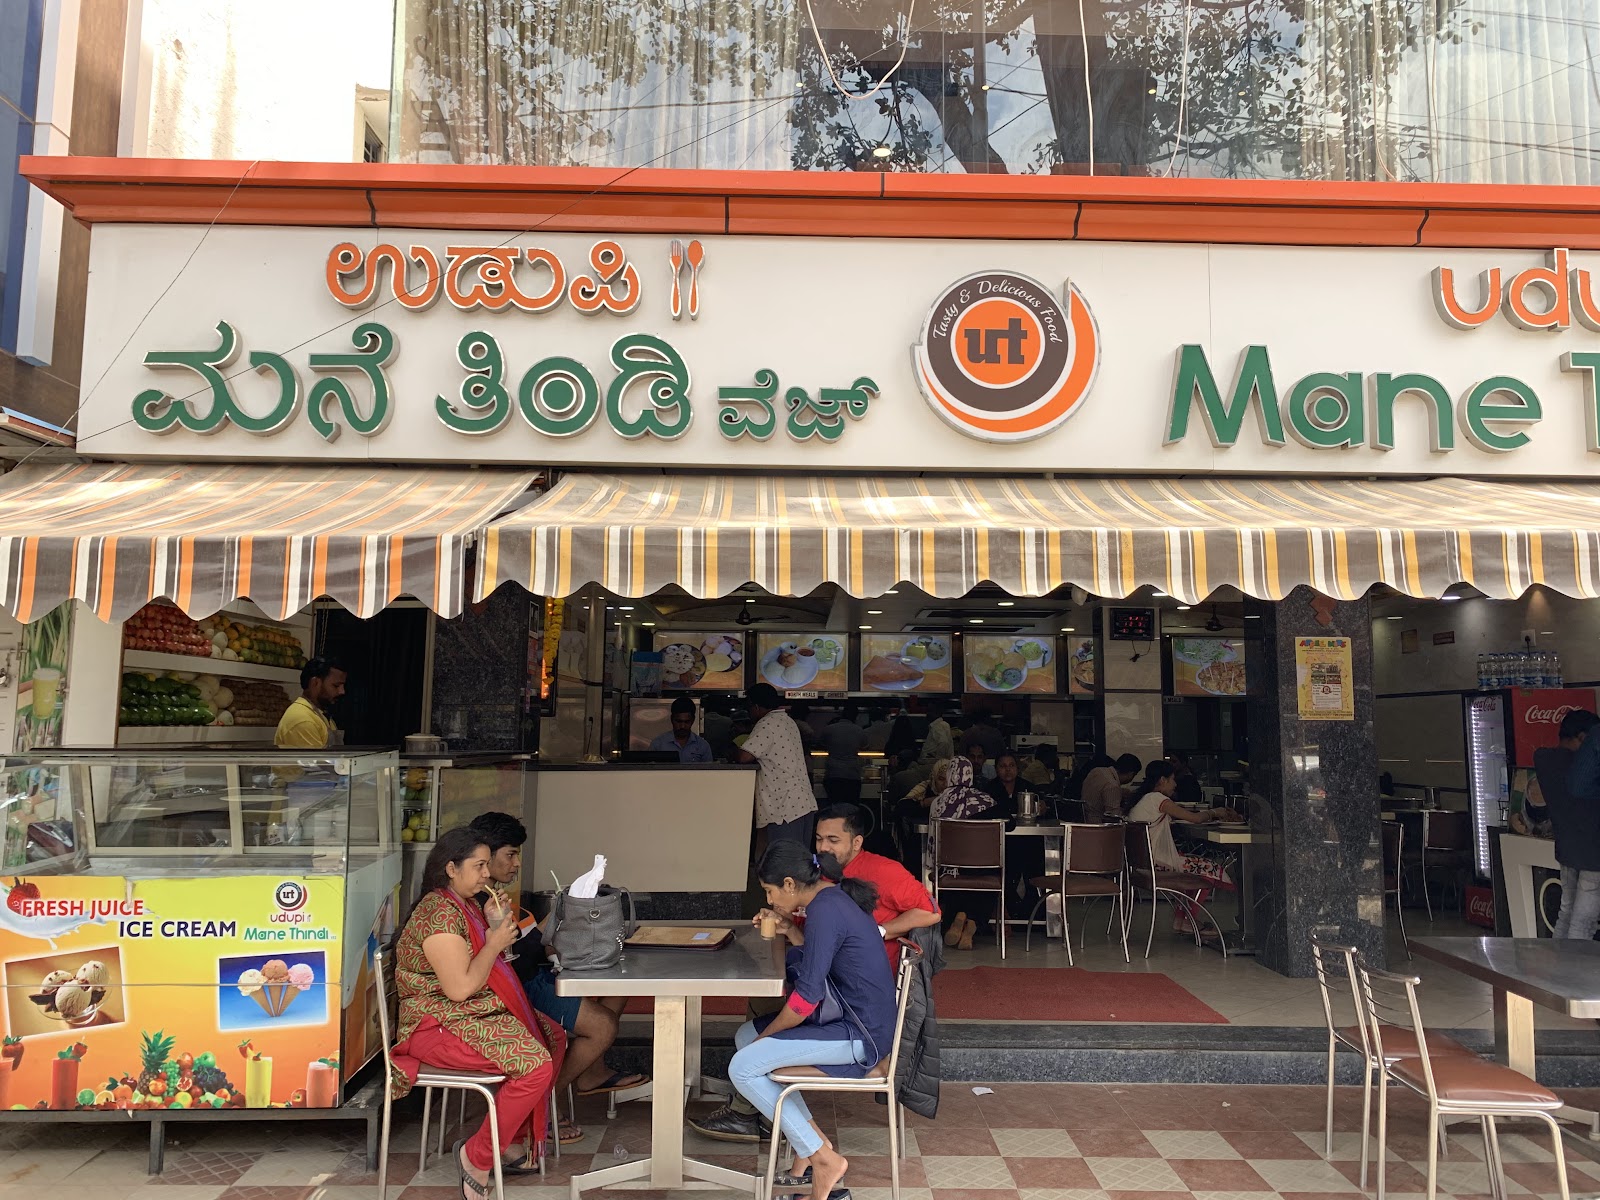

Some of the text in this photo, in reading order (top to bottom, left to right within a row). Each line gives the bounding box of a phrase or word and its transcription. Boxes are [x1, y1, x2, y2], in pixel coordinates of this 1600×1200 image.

[326, 239, 641, 315] ಉಡುಪಿ
[933, 279, 1063, 343] Tasty & Delicious Food
[131, 320, 881, 444] ಮನೆ ತಿಂಡಿ ವೆಜ್
[1162, 344, 1543, 454] Mane
[22, 899, 144, 919] FRESH JUICE
[119, 920, 236, 937] ICE CREAM
[270, 912, 305, 925] udupi
[244, 927, 329, 940] Mane Thindi
